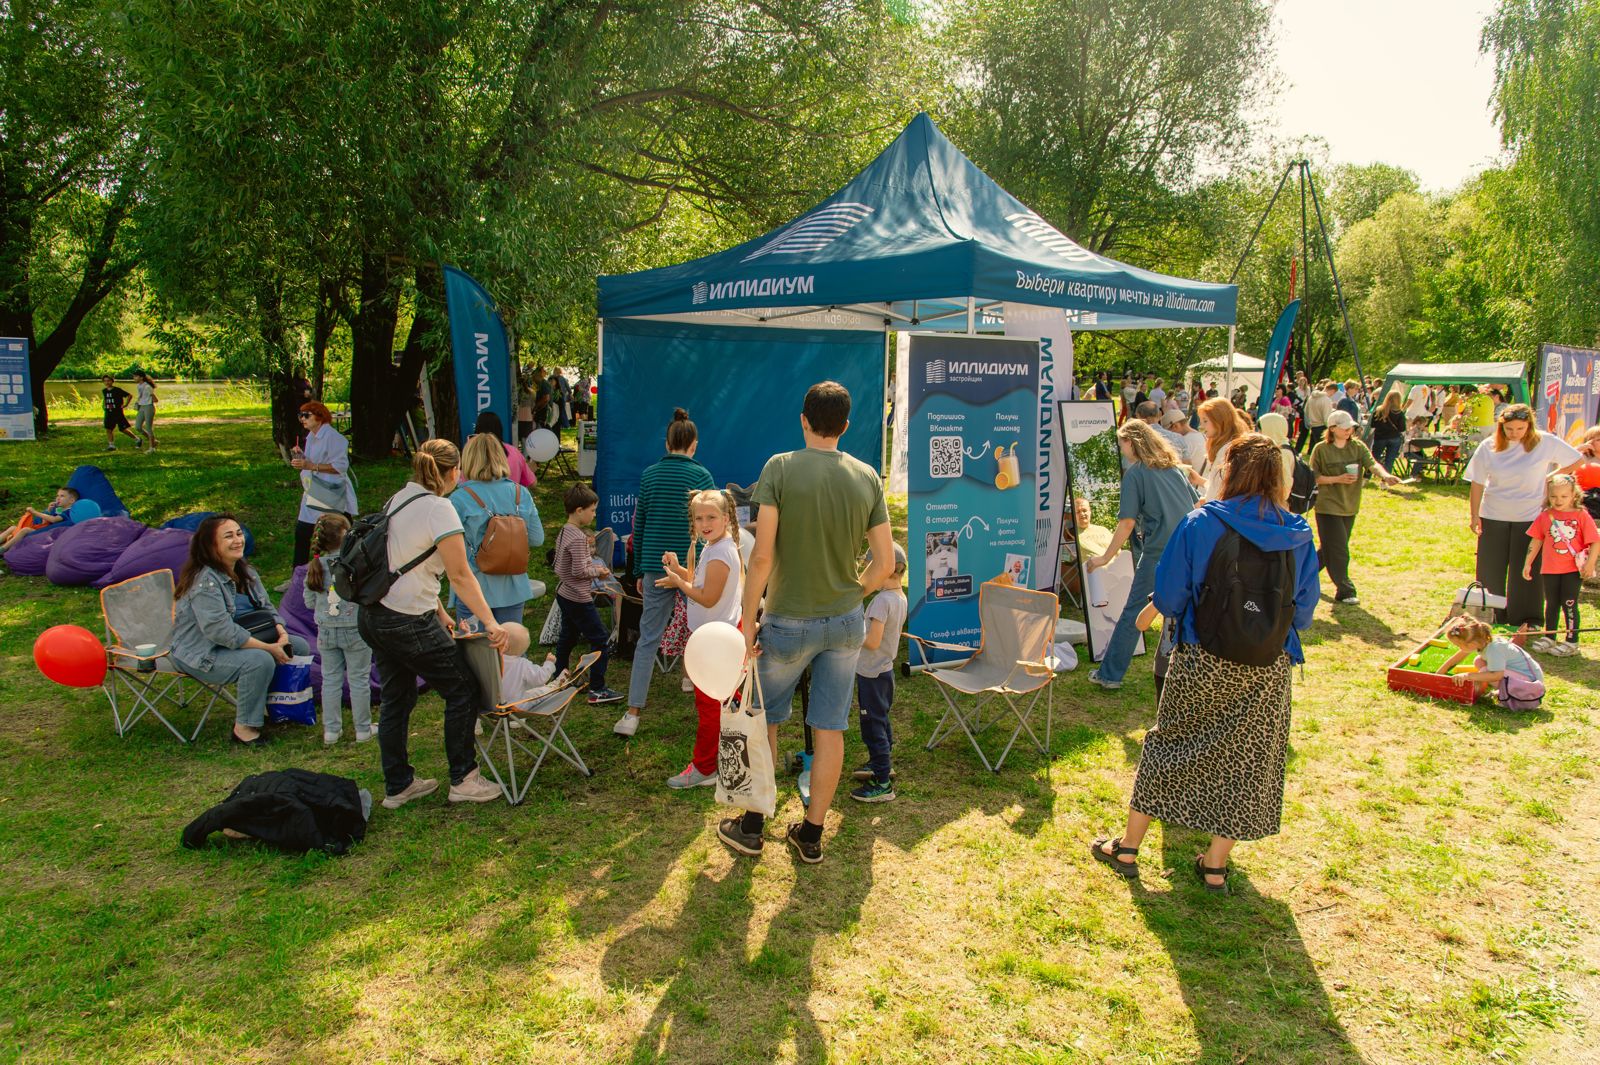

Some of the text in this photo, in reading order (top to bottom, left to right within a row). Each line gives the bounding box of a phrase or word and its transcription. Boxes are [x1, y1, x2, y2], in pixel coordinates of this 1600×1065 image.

[709, 275, 815, 300] ИЛЛИДИУМ
[1016, 270, 1215, 312] Выбери квартиру мечты на illidium.com
[948, 361, 1029, 376] ИЛЛИДИУМ
[927, 412, 966, 422] Подпишись
[995, 412, 1019, 422] Получи
[993, 425, 1021, 434] лимонад
[956, 627, 982, 636] аквагри
